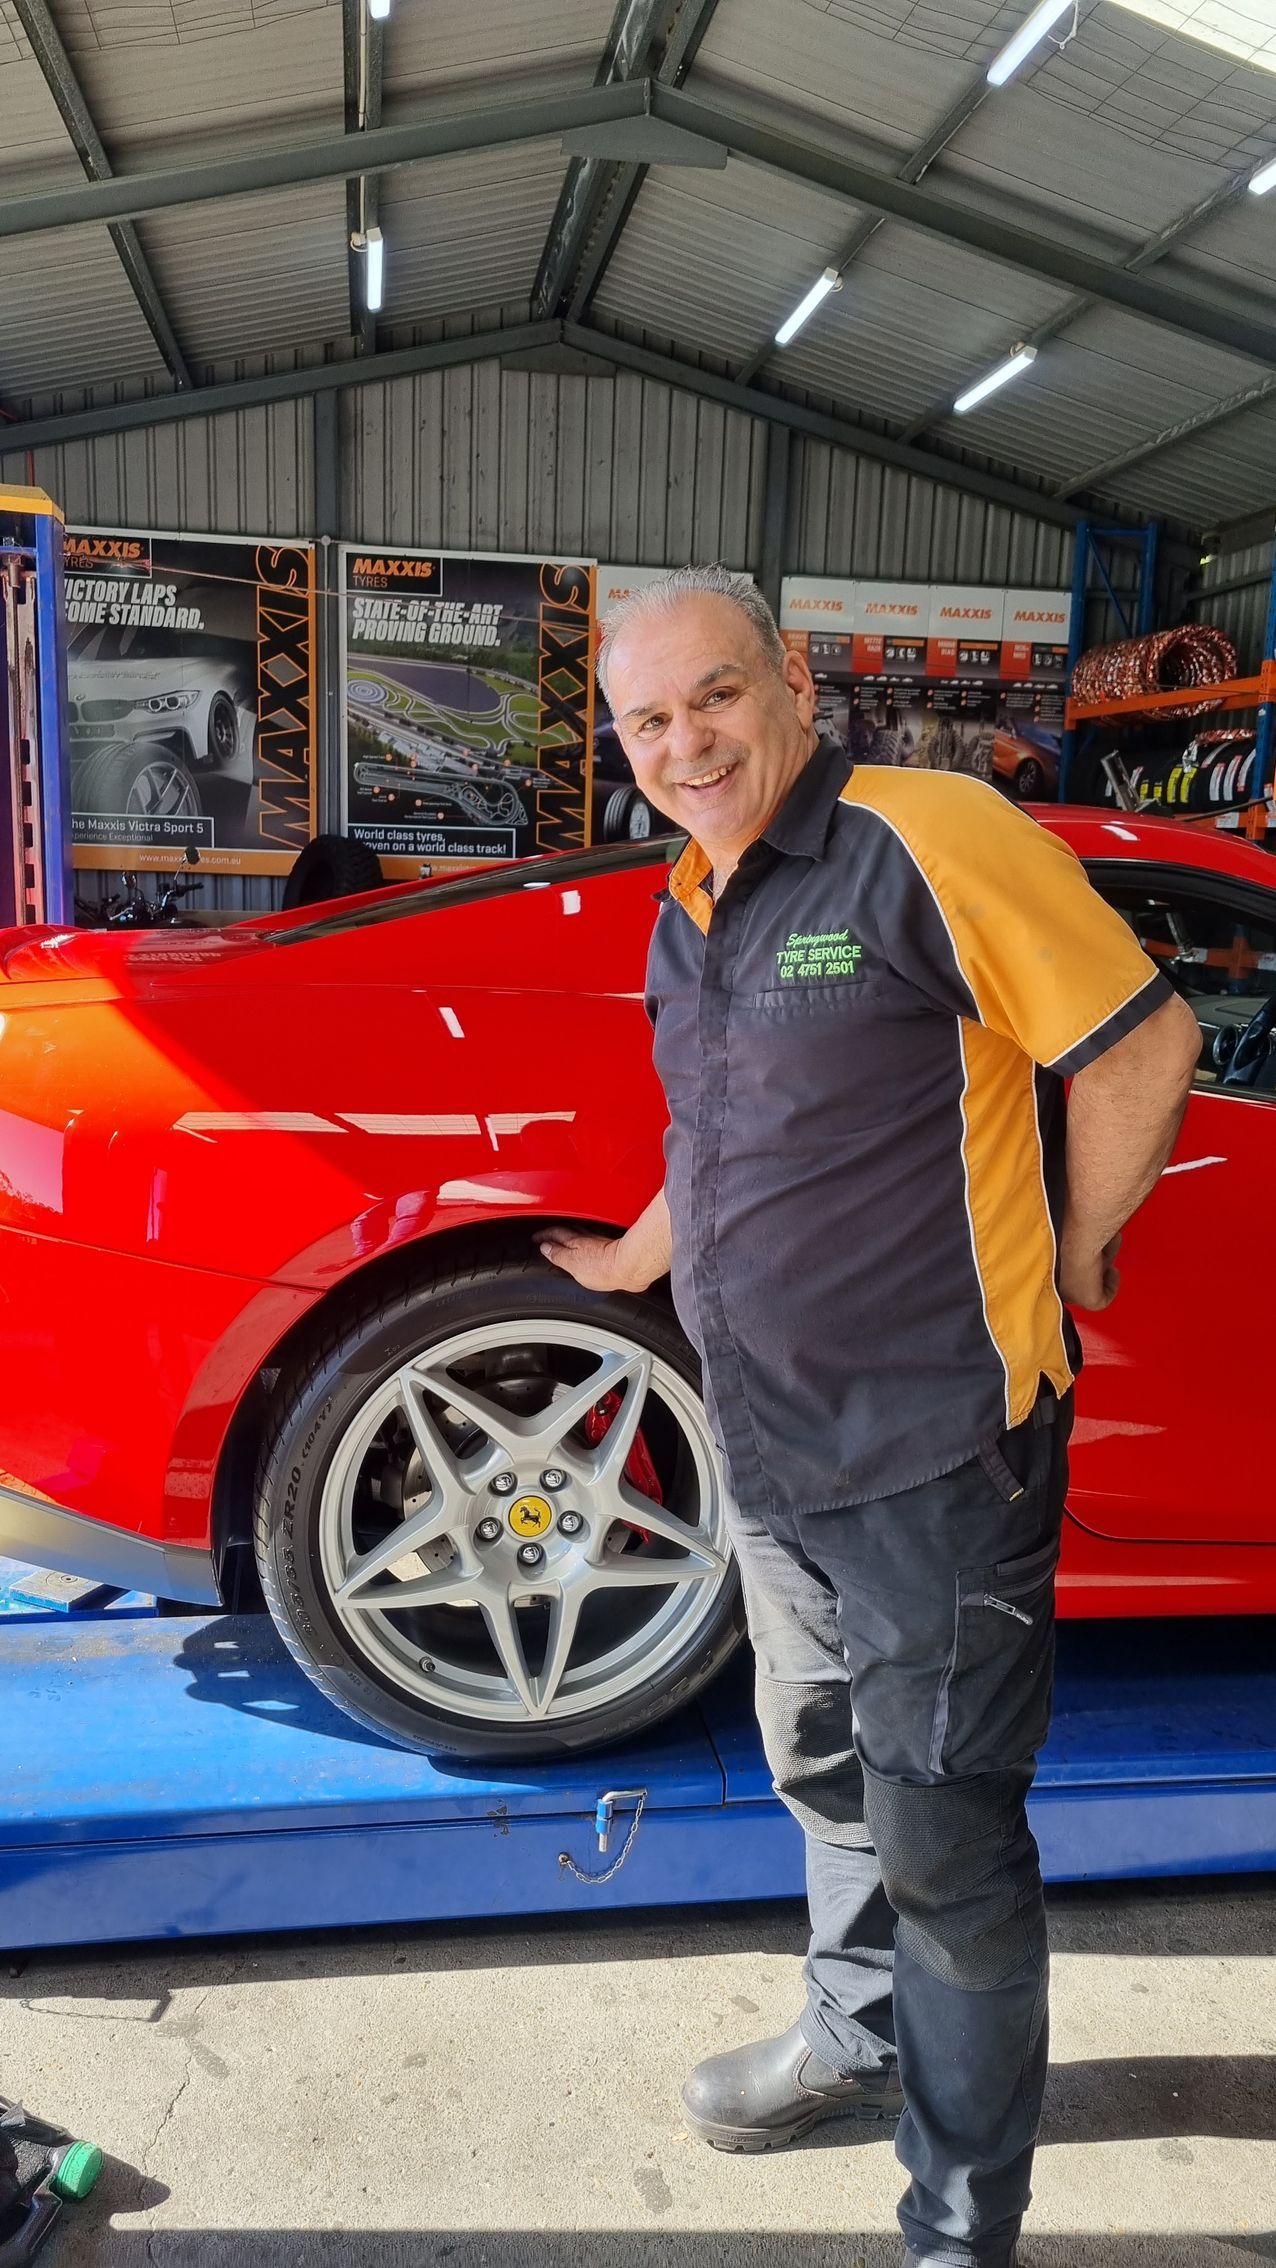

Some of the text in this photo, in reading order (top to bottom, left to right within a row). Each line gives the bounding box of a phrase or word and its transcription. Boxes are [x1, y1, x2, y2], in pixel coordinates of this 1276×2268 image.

[64, 555, 94, 569] YRES
[352, 558, 433, 578] MAXXIS
[353, 576, 388, 588] TYRES
[64, 578, 178, 606] ICTORY LAPS
[352, 597, 504, 625] STATE-OF-THE-ART
[789, 598, 844, 613] MAXXIS
[865, 602, 919, 616] MAXXIS
[940, 607, 993, 620] MAXXIS
[64, 601, 206, 630] OME STANDARD.
[1013, 610, 1067, 624] MAXXIS
[352, 619, 502, 647] PROVING GROUND.
[256, 544, 311, 851] MAXXIS
[536, 562, 590, 852] MAXXIS
[71, 819, 204, 835] he Maxxis Victra Sport 5
[353, 828, 446, 844] World class tyres,
[109, 833, 153, 844] Exceptional
[365, 841, 507, 855] oven on a world class track!
[786, 928, 849, 948] Springwood
[776, 945, 862, 965] TYRE SERVICE
[780, 960, 855, 978] 02 4751 2501
[281, 1465, 303, 1540] ZR20
